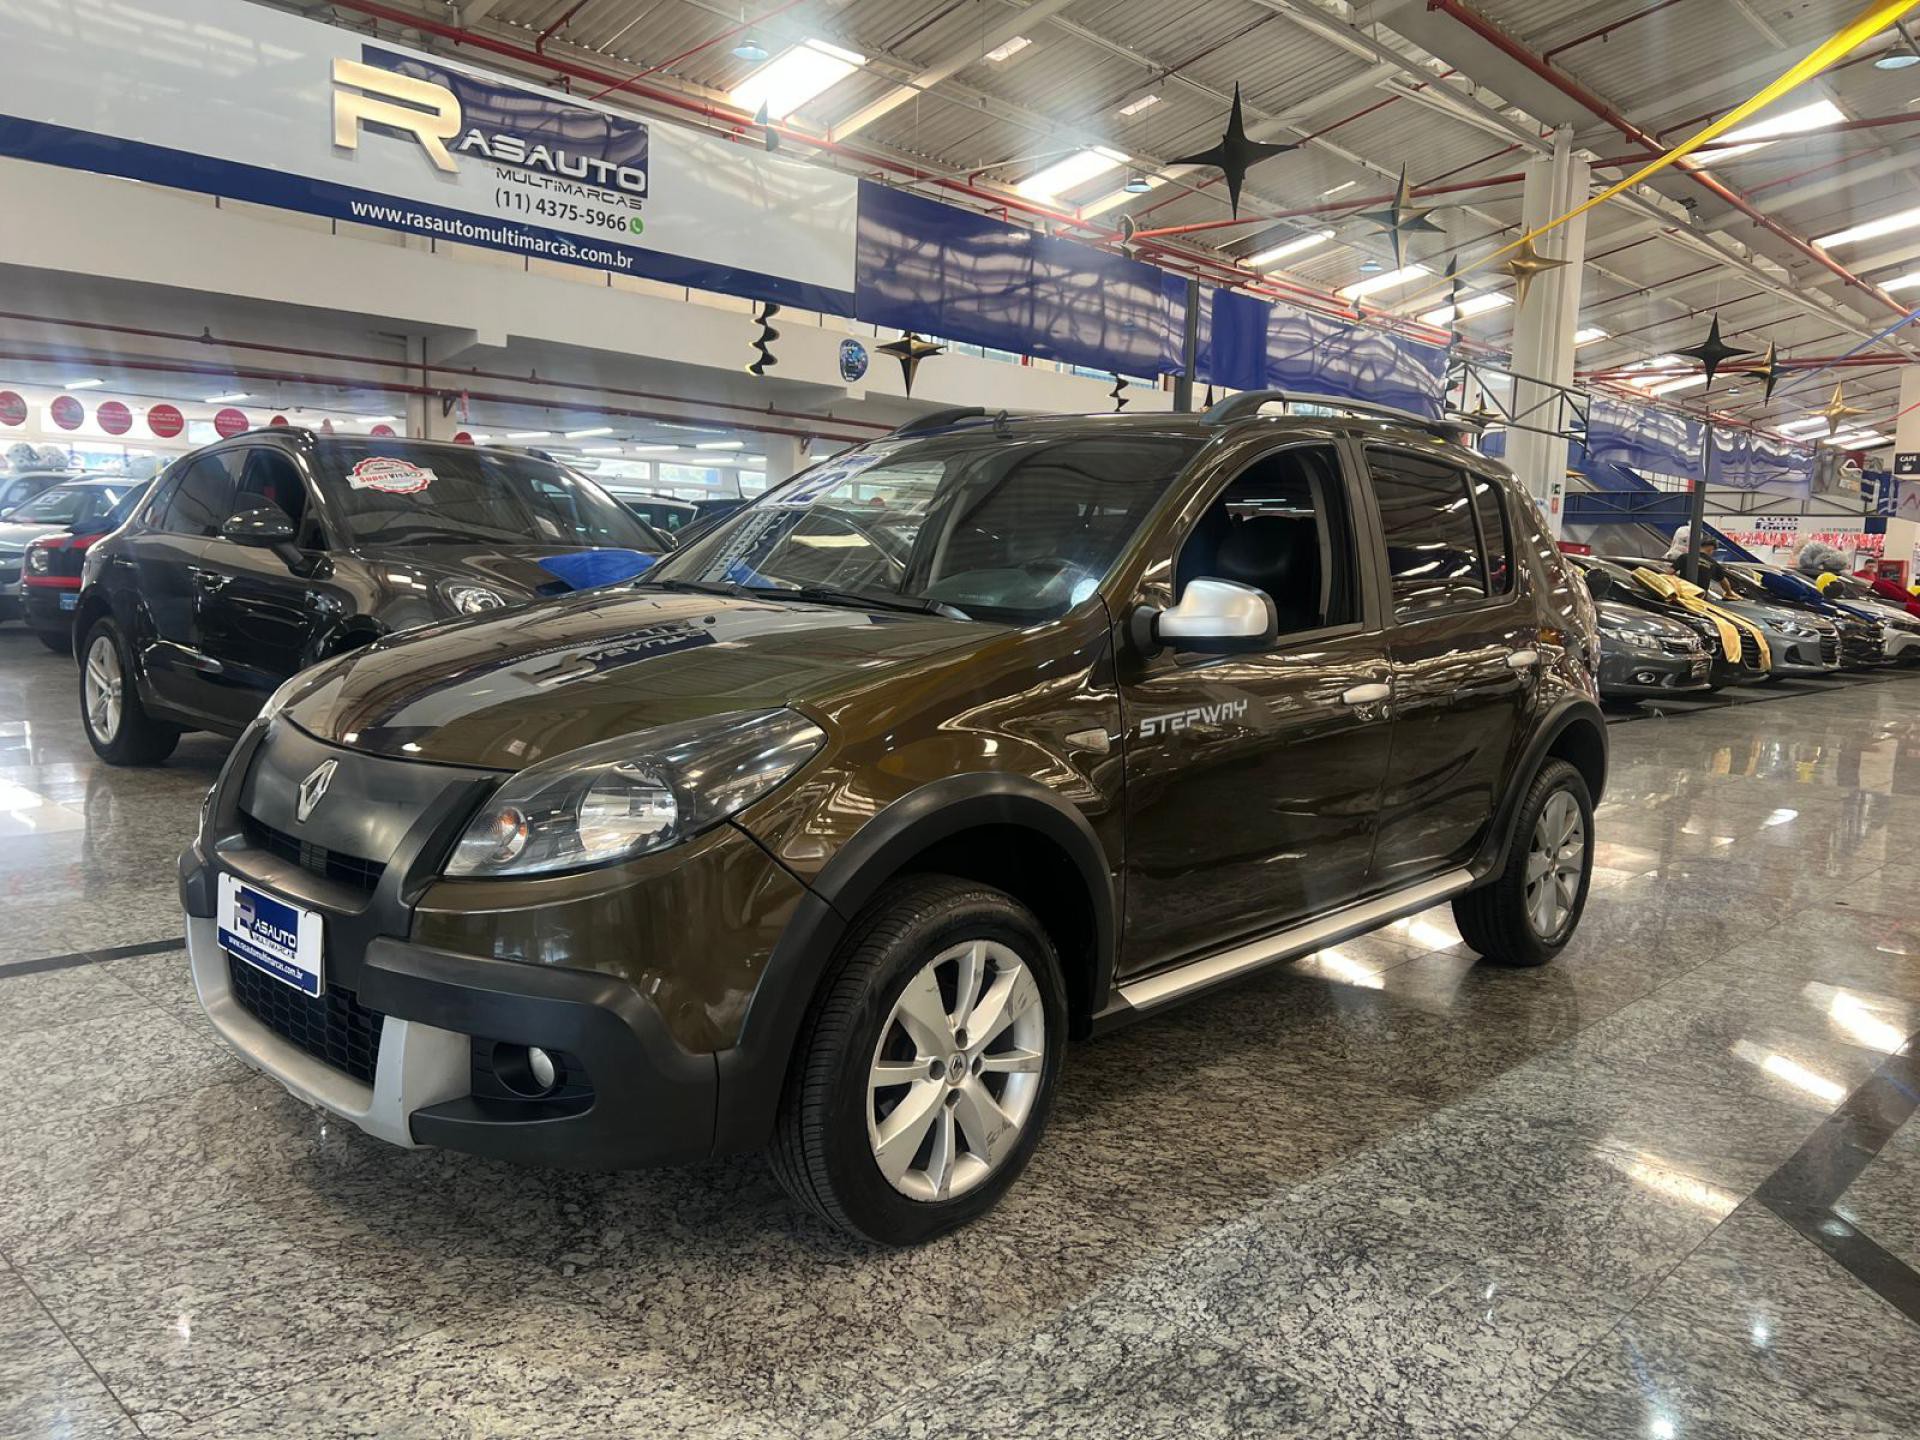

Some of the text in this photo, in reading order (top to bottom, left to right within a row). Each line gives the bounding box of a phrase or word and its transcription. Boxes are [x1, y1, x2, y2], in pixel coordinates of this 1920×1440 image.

[495, 187, 627, 232] (11) 4375-5966
[350, 200, 634, 269] www.rasautomultimarcas.com.br
[1139, 699, 1249, 739] STEPWAY
